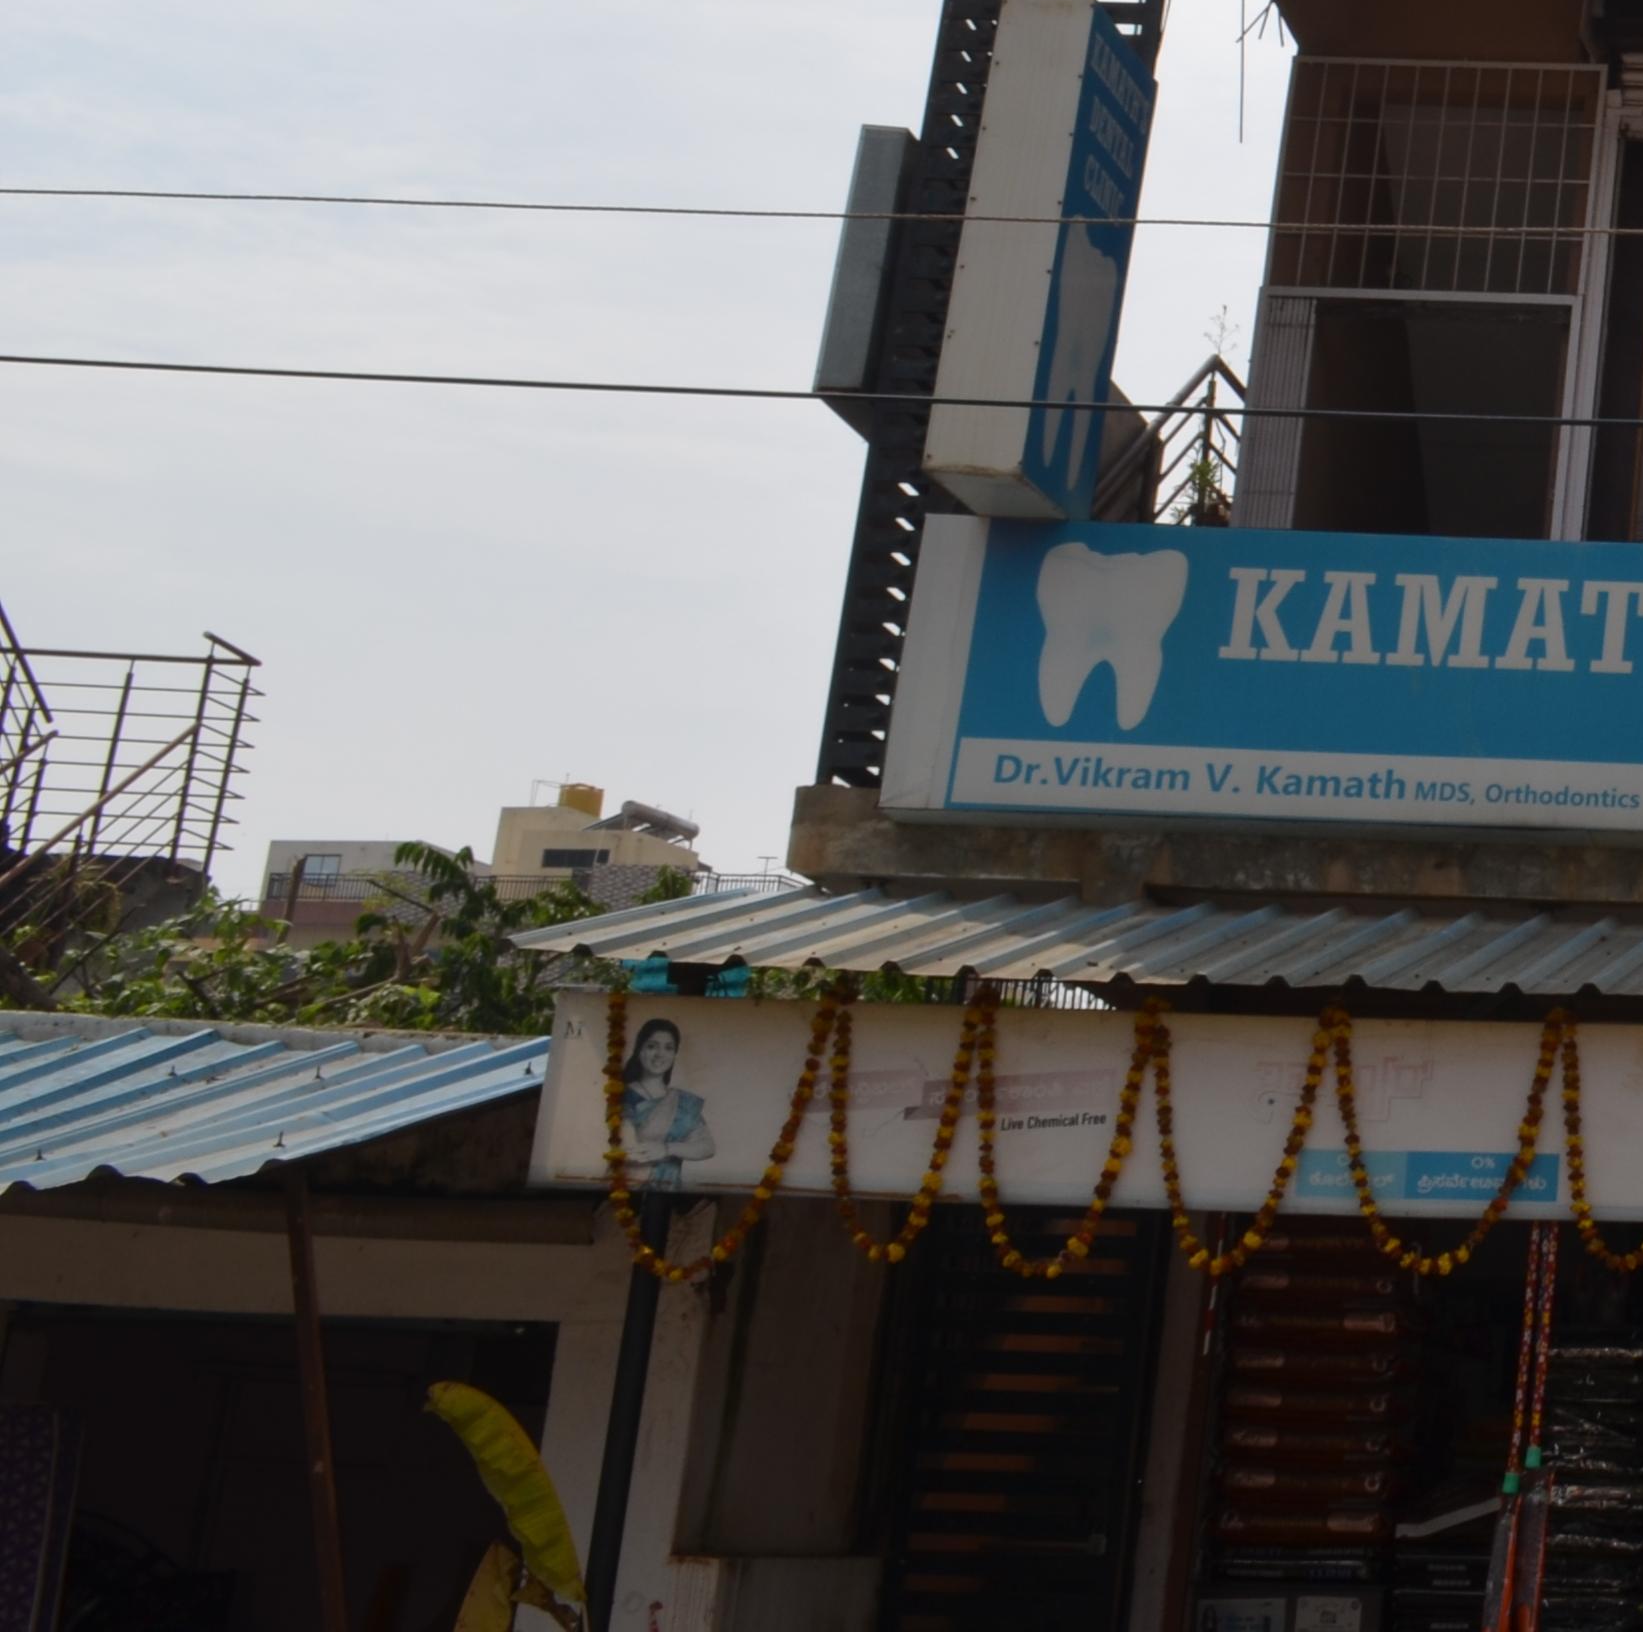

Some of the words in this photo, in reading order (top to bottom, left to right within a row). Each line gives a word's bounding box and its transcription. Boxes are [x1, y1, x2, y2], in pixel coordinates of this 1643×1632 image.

[1088, 94, 1137, 182] DENTAL
[1083, 153, 1126, 228] CLINIC
[992, 754, 1191, 792] Dr.Vikram
[1205, 762, 1241, 795] V.
[1256, 765, 1408, 801] Kamath
[1413, 781, 1477, 807] MDS,
[1484, 782, 1641, 810] Orthodontics
[999, 1116, 1024, 1132] Live
[1026, 1112, 1079, 1130] Chemical
[1080, 1110, 1108, 1127] Free
